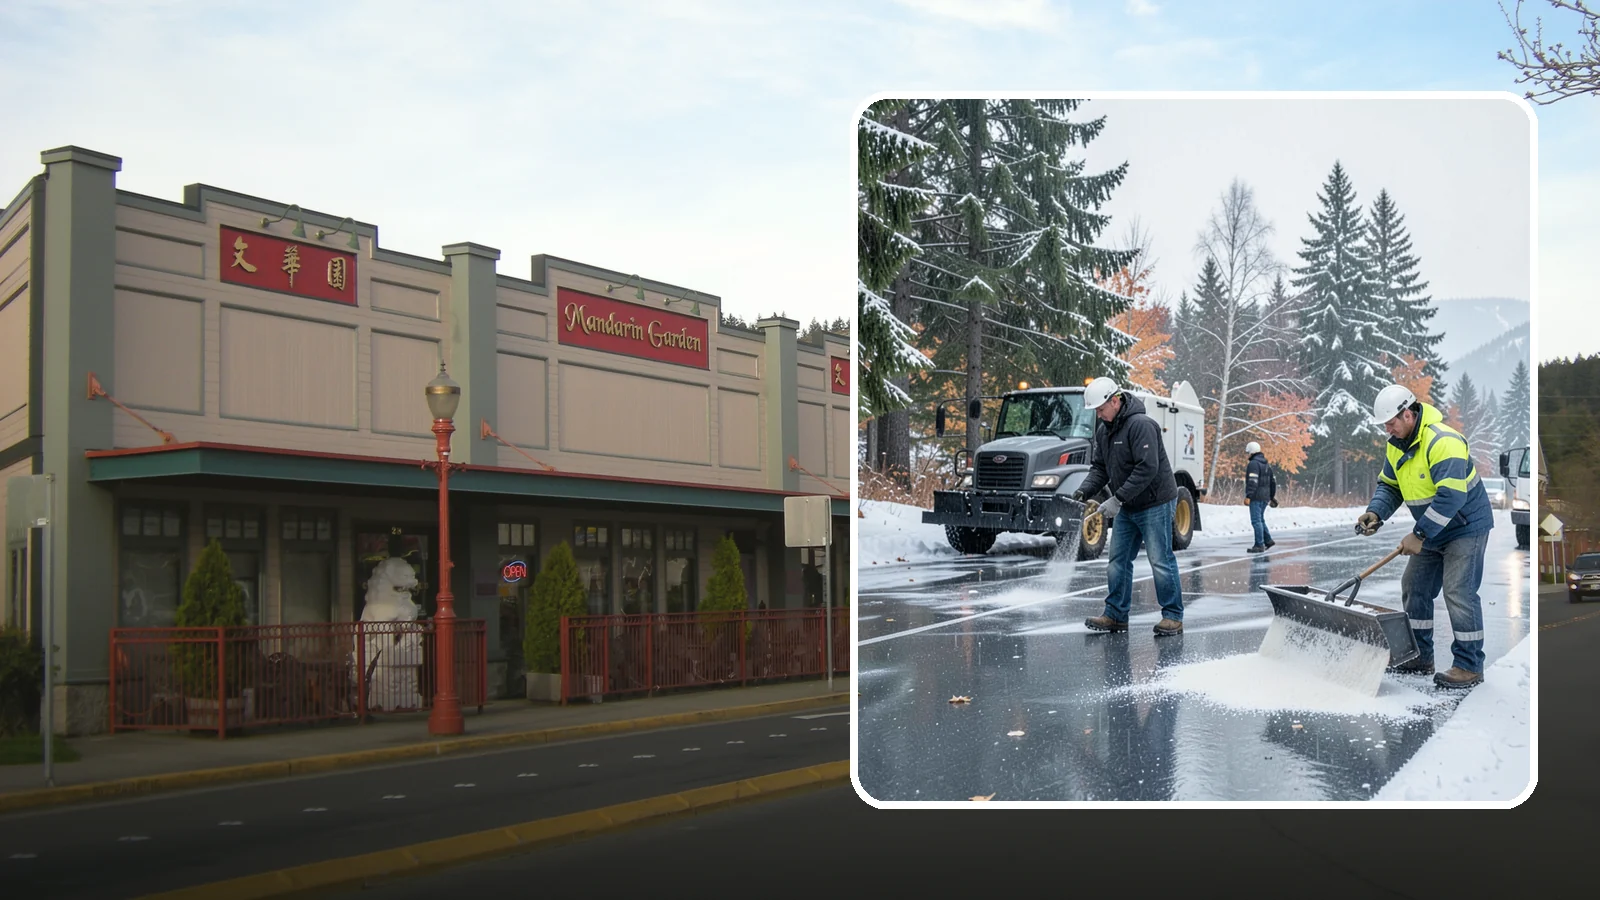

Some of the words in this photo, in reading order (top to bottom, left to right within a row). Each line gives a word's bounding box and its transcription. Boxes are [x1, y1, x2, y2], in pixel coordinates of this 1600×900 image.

[564, 302, 644, 341] Mandarin
[648, 320, 702, 352] Garden
[503, 565, 527, 578] OPEN
